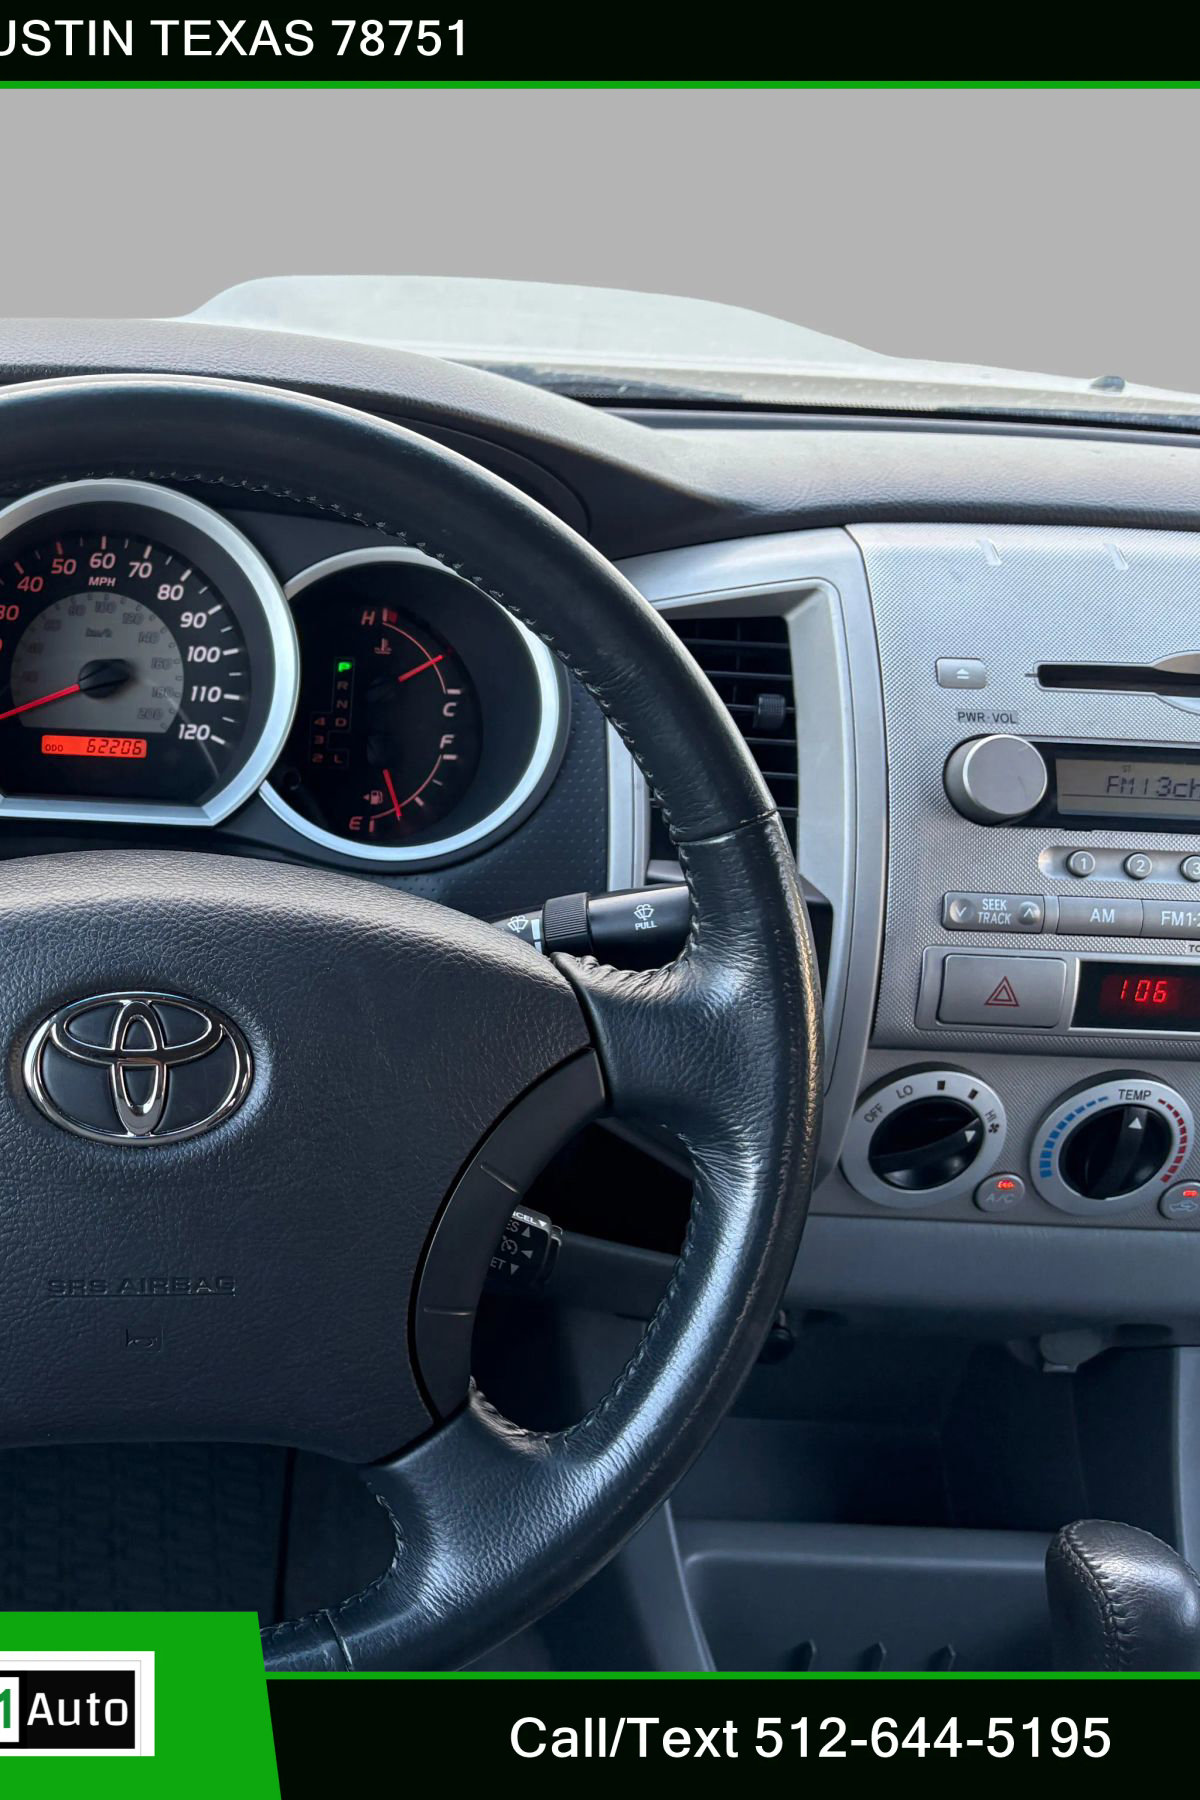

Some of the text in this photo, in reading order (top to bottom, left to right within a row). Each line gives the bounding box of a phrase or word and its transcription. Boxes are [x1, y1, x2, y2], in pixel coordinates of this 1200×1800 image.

[51, 558, 77, 575] 50
[89, 553, 116, 569] 60
[128, 562, 152, 578] 70
[17, 576, 44, 592] 40
[88, 576, 116, 587] MPH
[157, 584, 184, 601] 80
[180, 612, 207, 629] 90
[360, 610, 376, 626] H
[187, 646, 220, 663] 100
[338, 662, 352, 672] P
[336, 680, 349, 690] R
[191, 686, 221, 702] 110
[336, 700, 348, 709] N
[442, 702, 457, 717] C
[957, 711, 1017, 724] PWR VOL
[178, 723, 211, 741] 120
[45, 738, 143, 756] ODO 62206
[440, 735, 455, 749] F
[349, 815, 363, 831] E
[1080, 858, 1087, 870] 1
[1135, 860, 1145, 872] 2
[1192, 862, 1200, 875] 3
[981, 898, 1008, 912] SEEK
[977, 911, 1012, 925] TRACK
[1089, 908, 1115, 923] AM
[634, 920, 658, 931] PULL
[895, 1083, 914, 1100] LO
[1117, 1088, 1152, 1101] TEMP
[863, 1103, 885, 1125] OFF
[984, 1110, 998, 1125] HI
[48, 1275, 237, 1296] SRS AIRBAG
